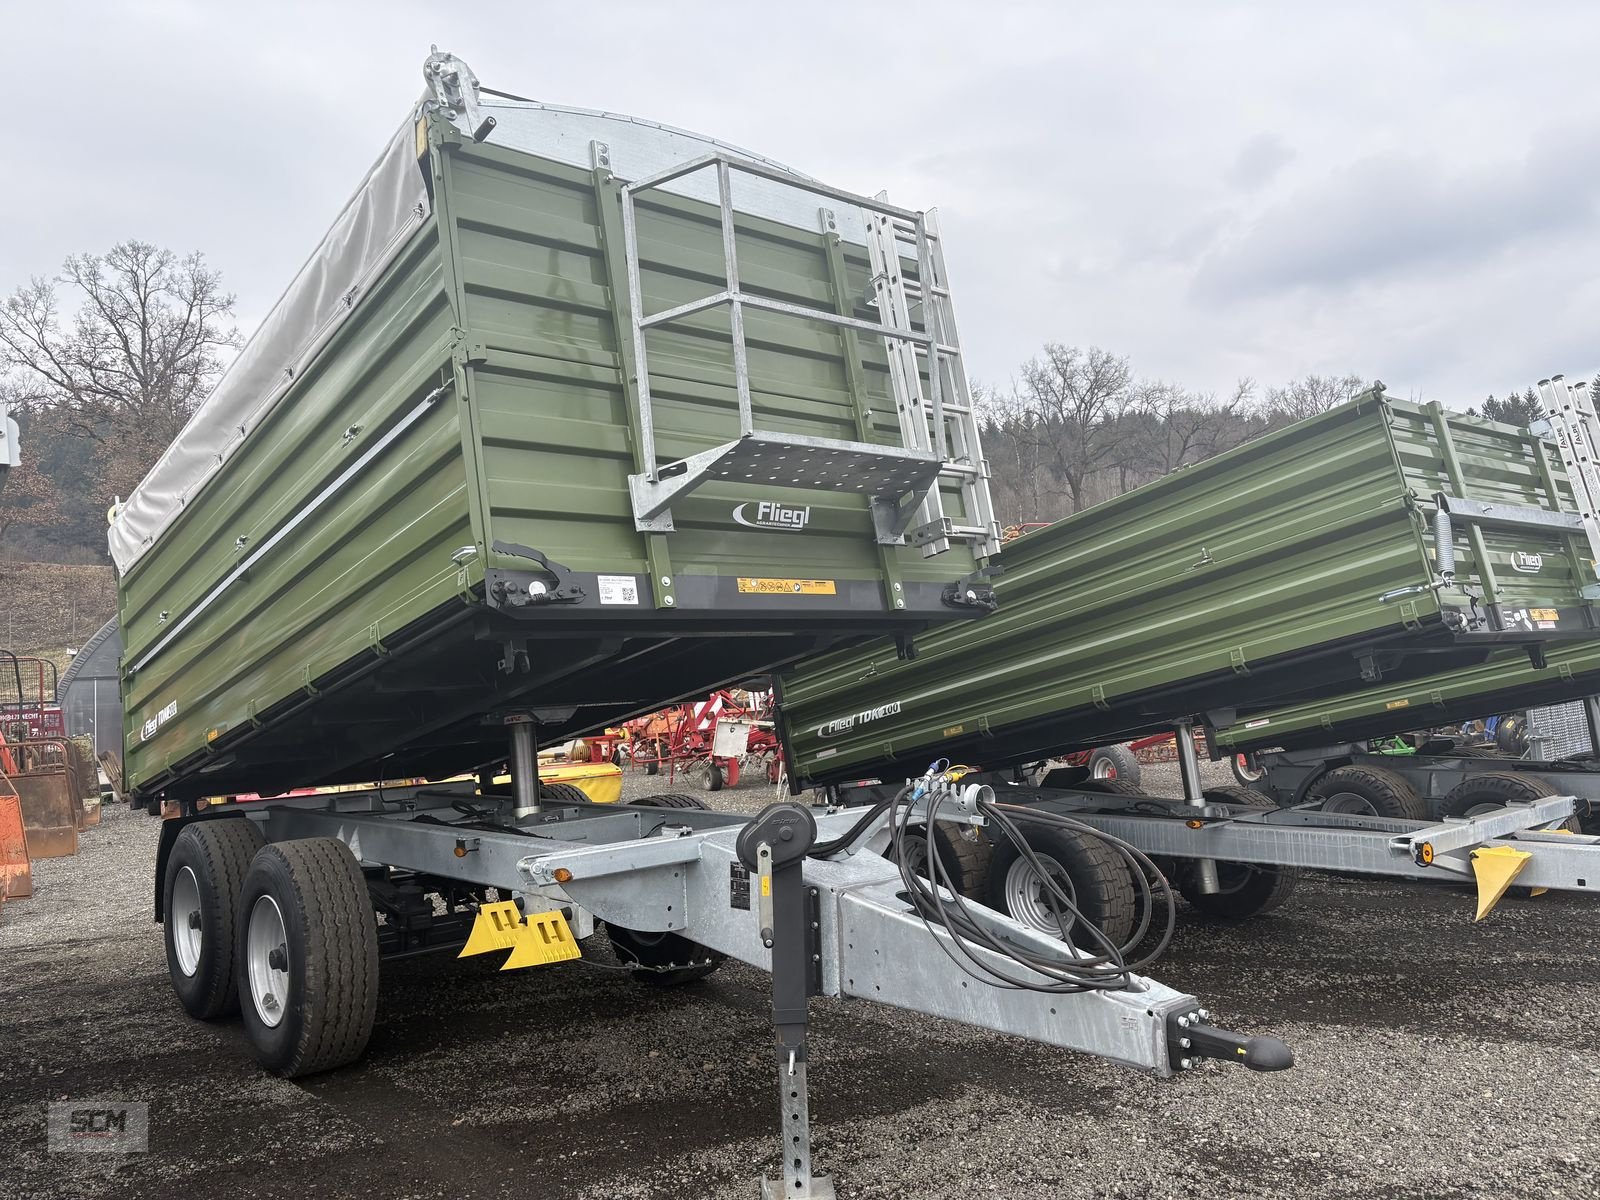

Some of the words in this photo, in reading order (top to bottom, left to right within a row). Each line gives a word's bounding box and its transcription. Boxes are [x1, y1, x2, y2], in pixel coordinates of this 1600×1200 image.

[757, 501, 811, 528] Fliegl
[1516, 551, 1543, 570] Fliegl
[145, 713, 158, 738] Fliegl
[828, 714, 856, 733] Fliegl
